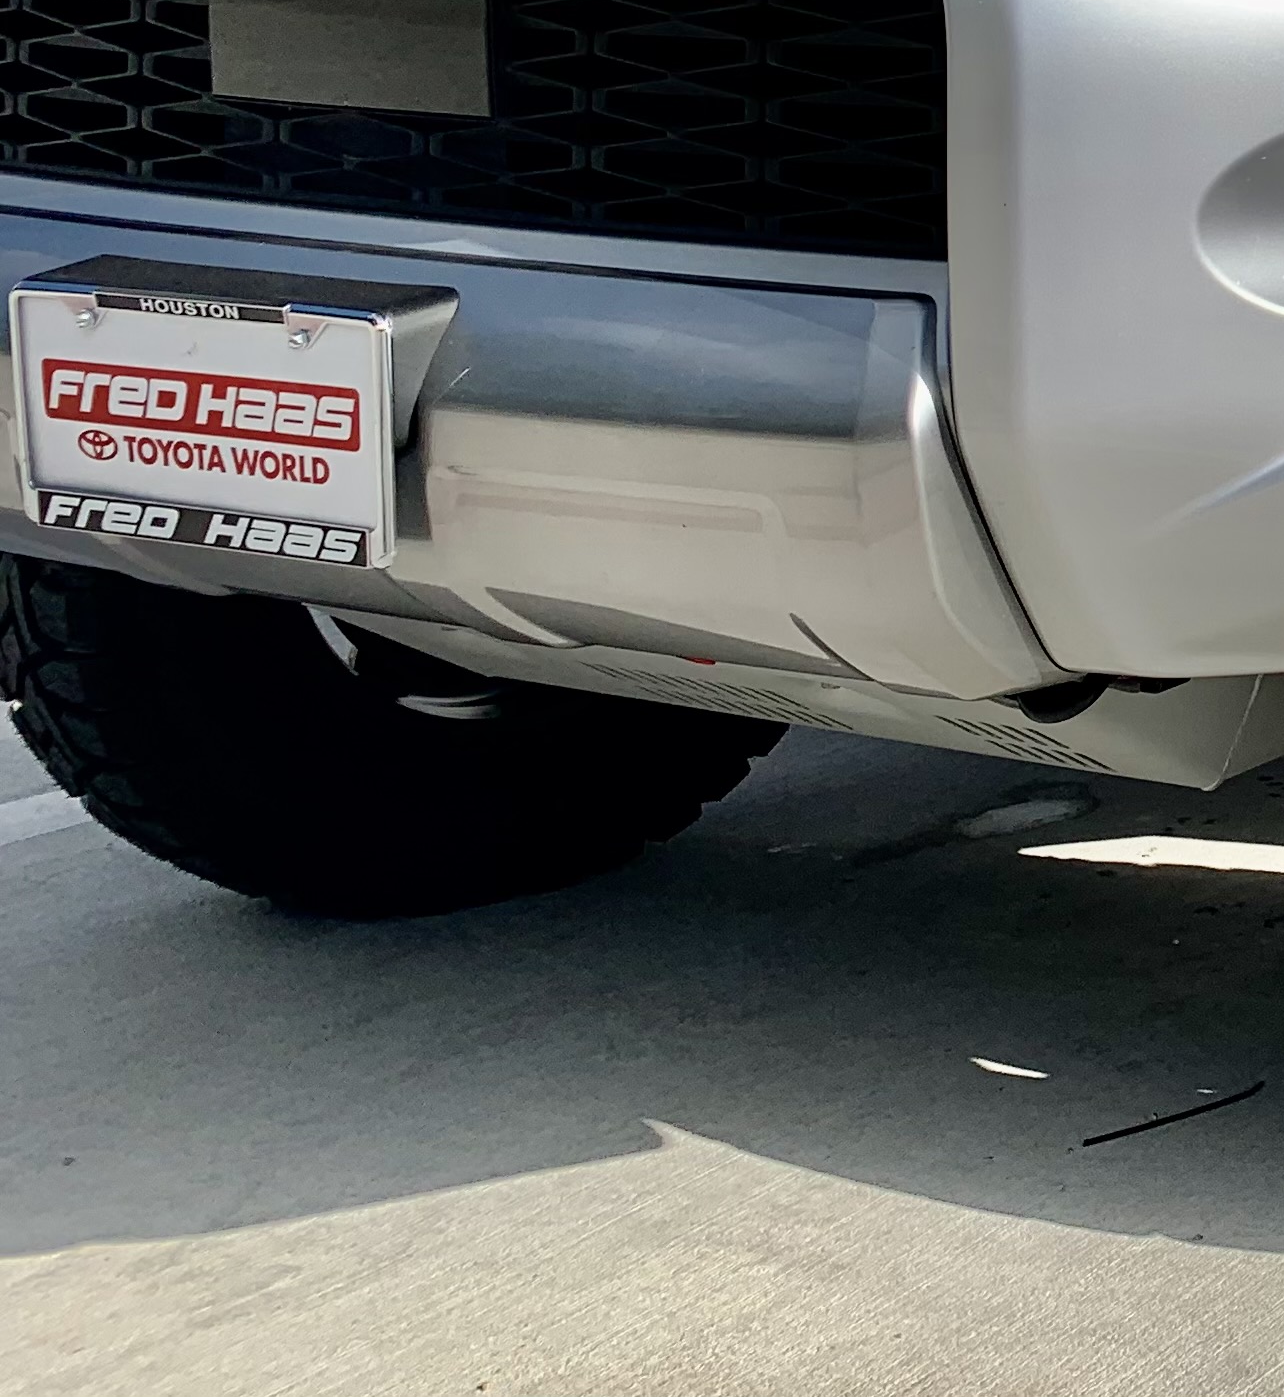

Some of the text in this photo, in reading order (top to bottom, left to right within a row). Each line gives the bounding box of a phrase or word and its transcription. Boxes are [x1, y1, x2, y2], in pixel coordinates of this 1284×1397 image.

[140, 297, 240, 320] HOUSTON
[124, 435, 330, 484] TOYOTA WORLD
